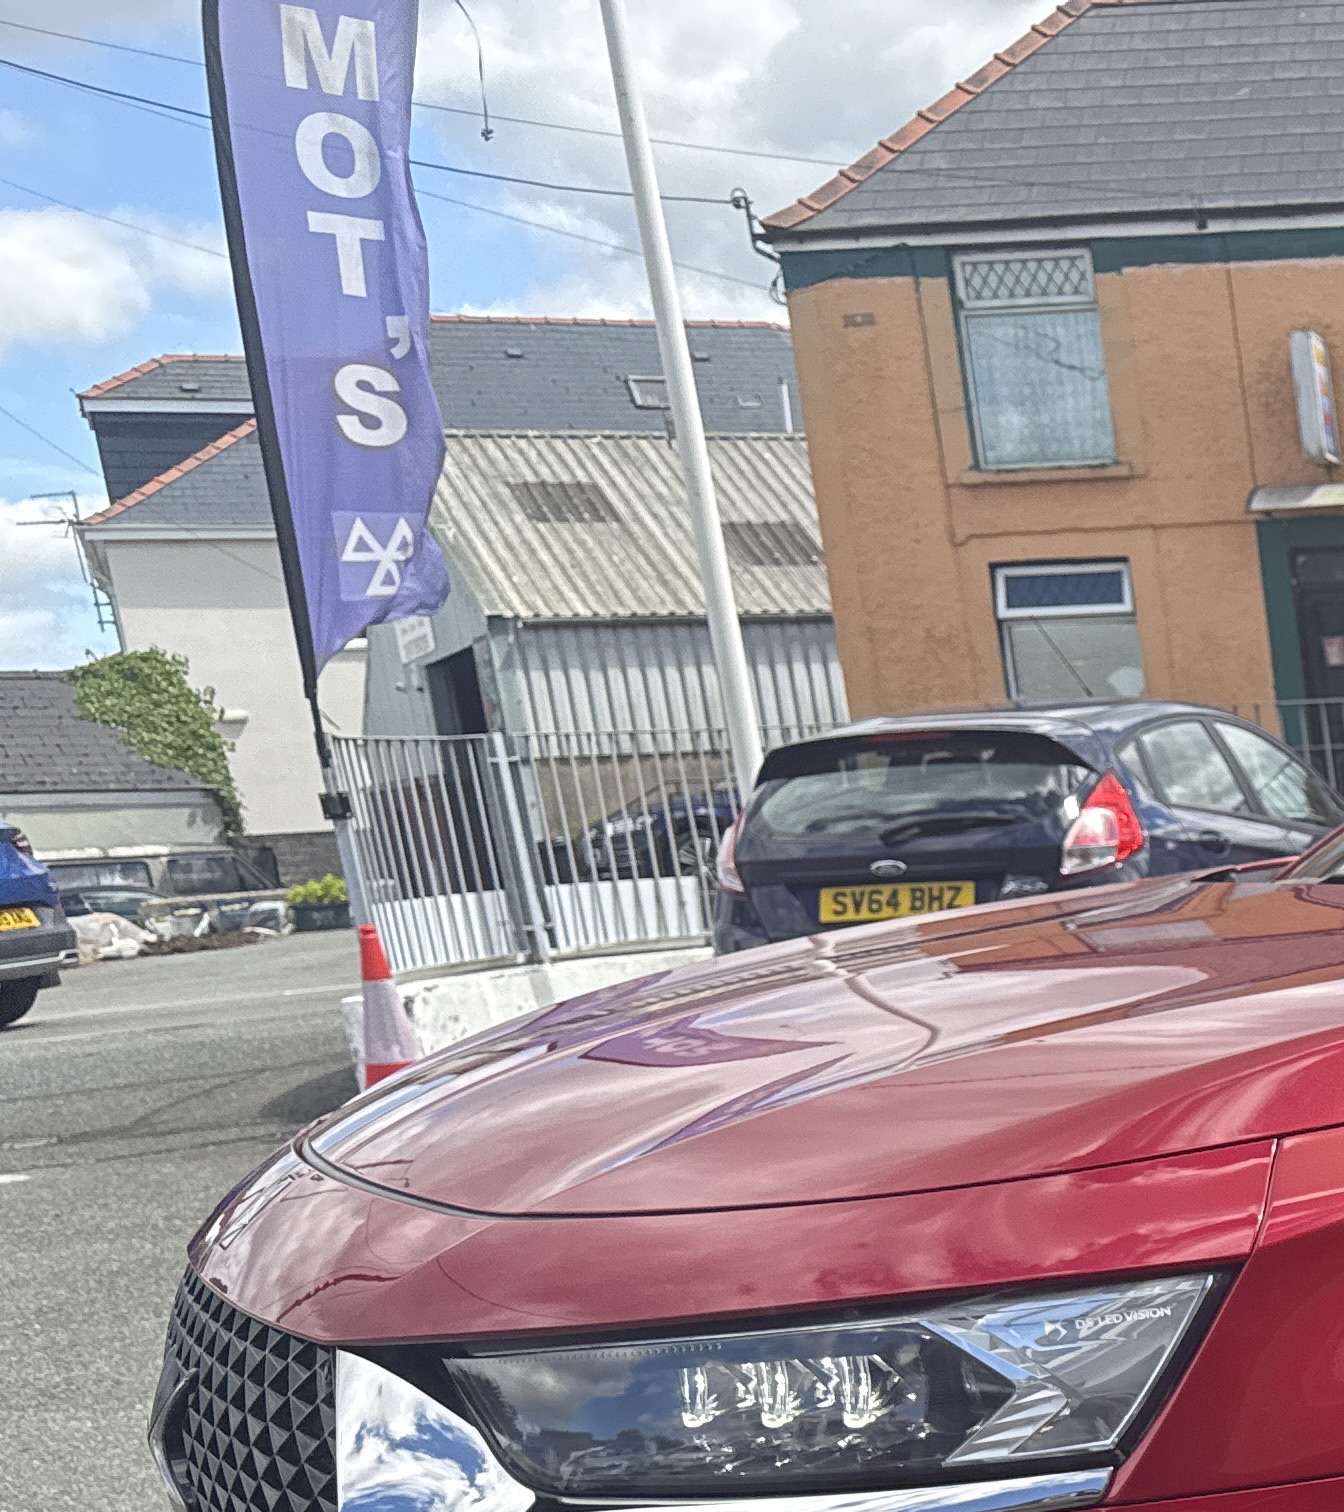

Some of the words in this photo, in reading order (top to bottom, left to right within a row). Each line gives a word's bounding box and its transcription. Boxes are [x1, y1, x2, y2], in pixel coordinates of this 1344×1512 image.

[279, 3, 411, 448] MOT'S
[832, 888, 900, 916] SV64
[909, 885, 963, 912] BHZ
[1099, 1312, 1123, 1325] LED
[1123, 1305, 1172, 1321] VISION
